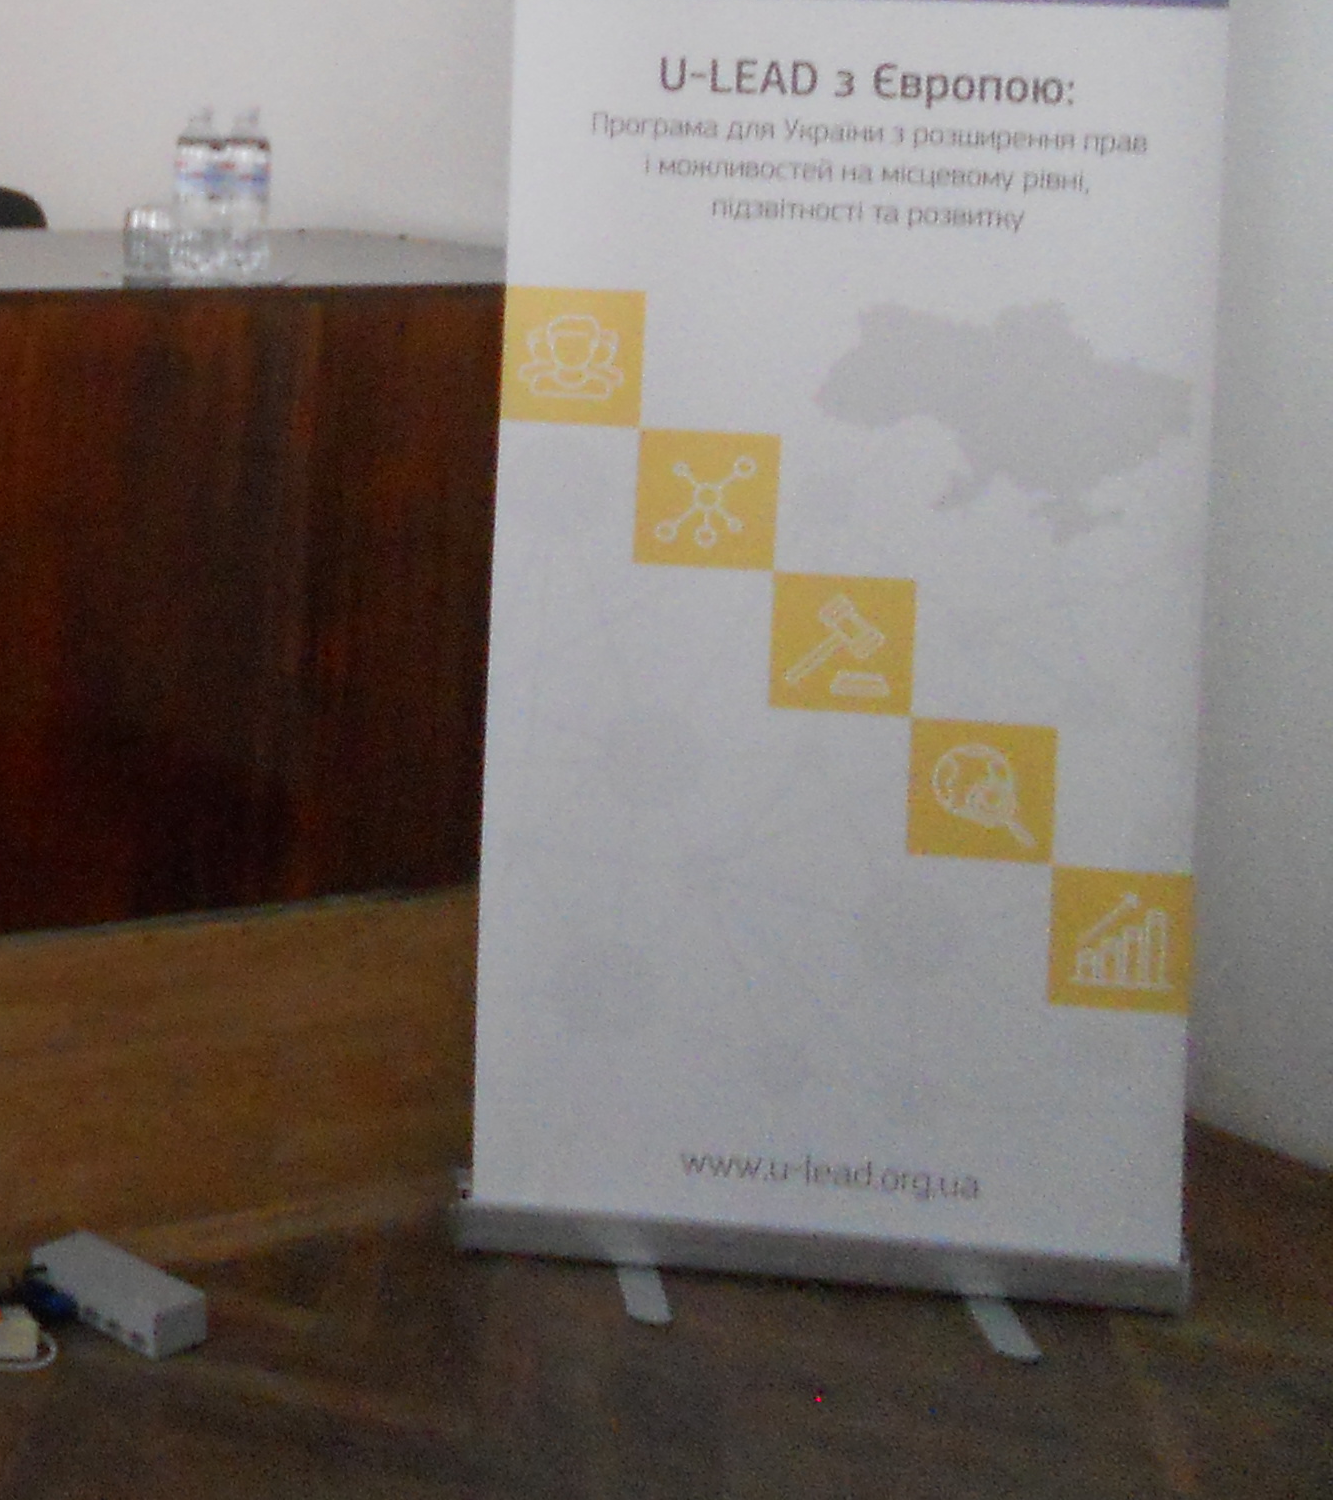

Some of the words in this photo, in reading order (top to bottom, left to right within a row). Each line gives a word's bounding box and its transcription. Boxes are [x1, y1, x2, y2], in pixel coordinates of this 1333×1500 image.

[659, 56, 819, 97] U-LEAD
[834, 70, 855, 98] з
[872, 62, 1075, 110] Європою:
[591, 110, 717, 141] Програма
[725, 118, 776, 144] для
[784, 117, 884, 147] України
[912, 126, 1076, 154] розширення
[1083, 132, 1148, 156] прав
[658, 155, 834, 183] можливостей
[841, 163, 873, 185] на
[881, 164, 1014, 192] місцевому
[1022, 169, 1090, 196] рівні,
[711, 197, 863, 223] підзвітності
[875, 205, 900, 225] та
[907, 204, 1026, 234] розвитку
[680, 1153, 980, 1201] www.u-lead.org.ua
